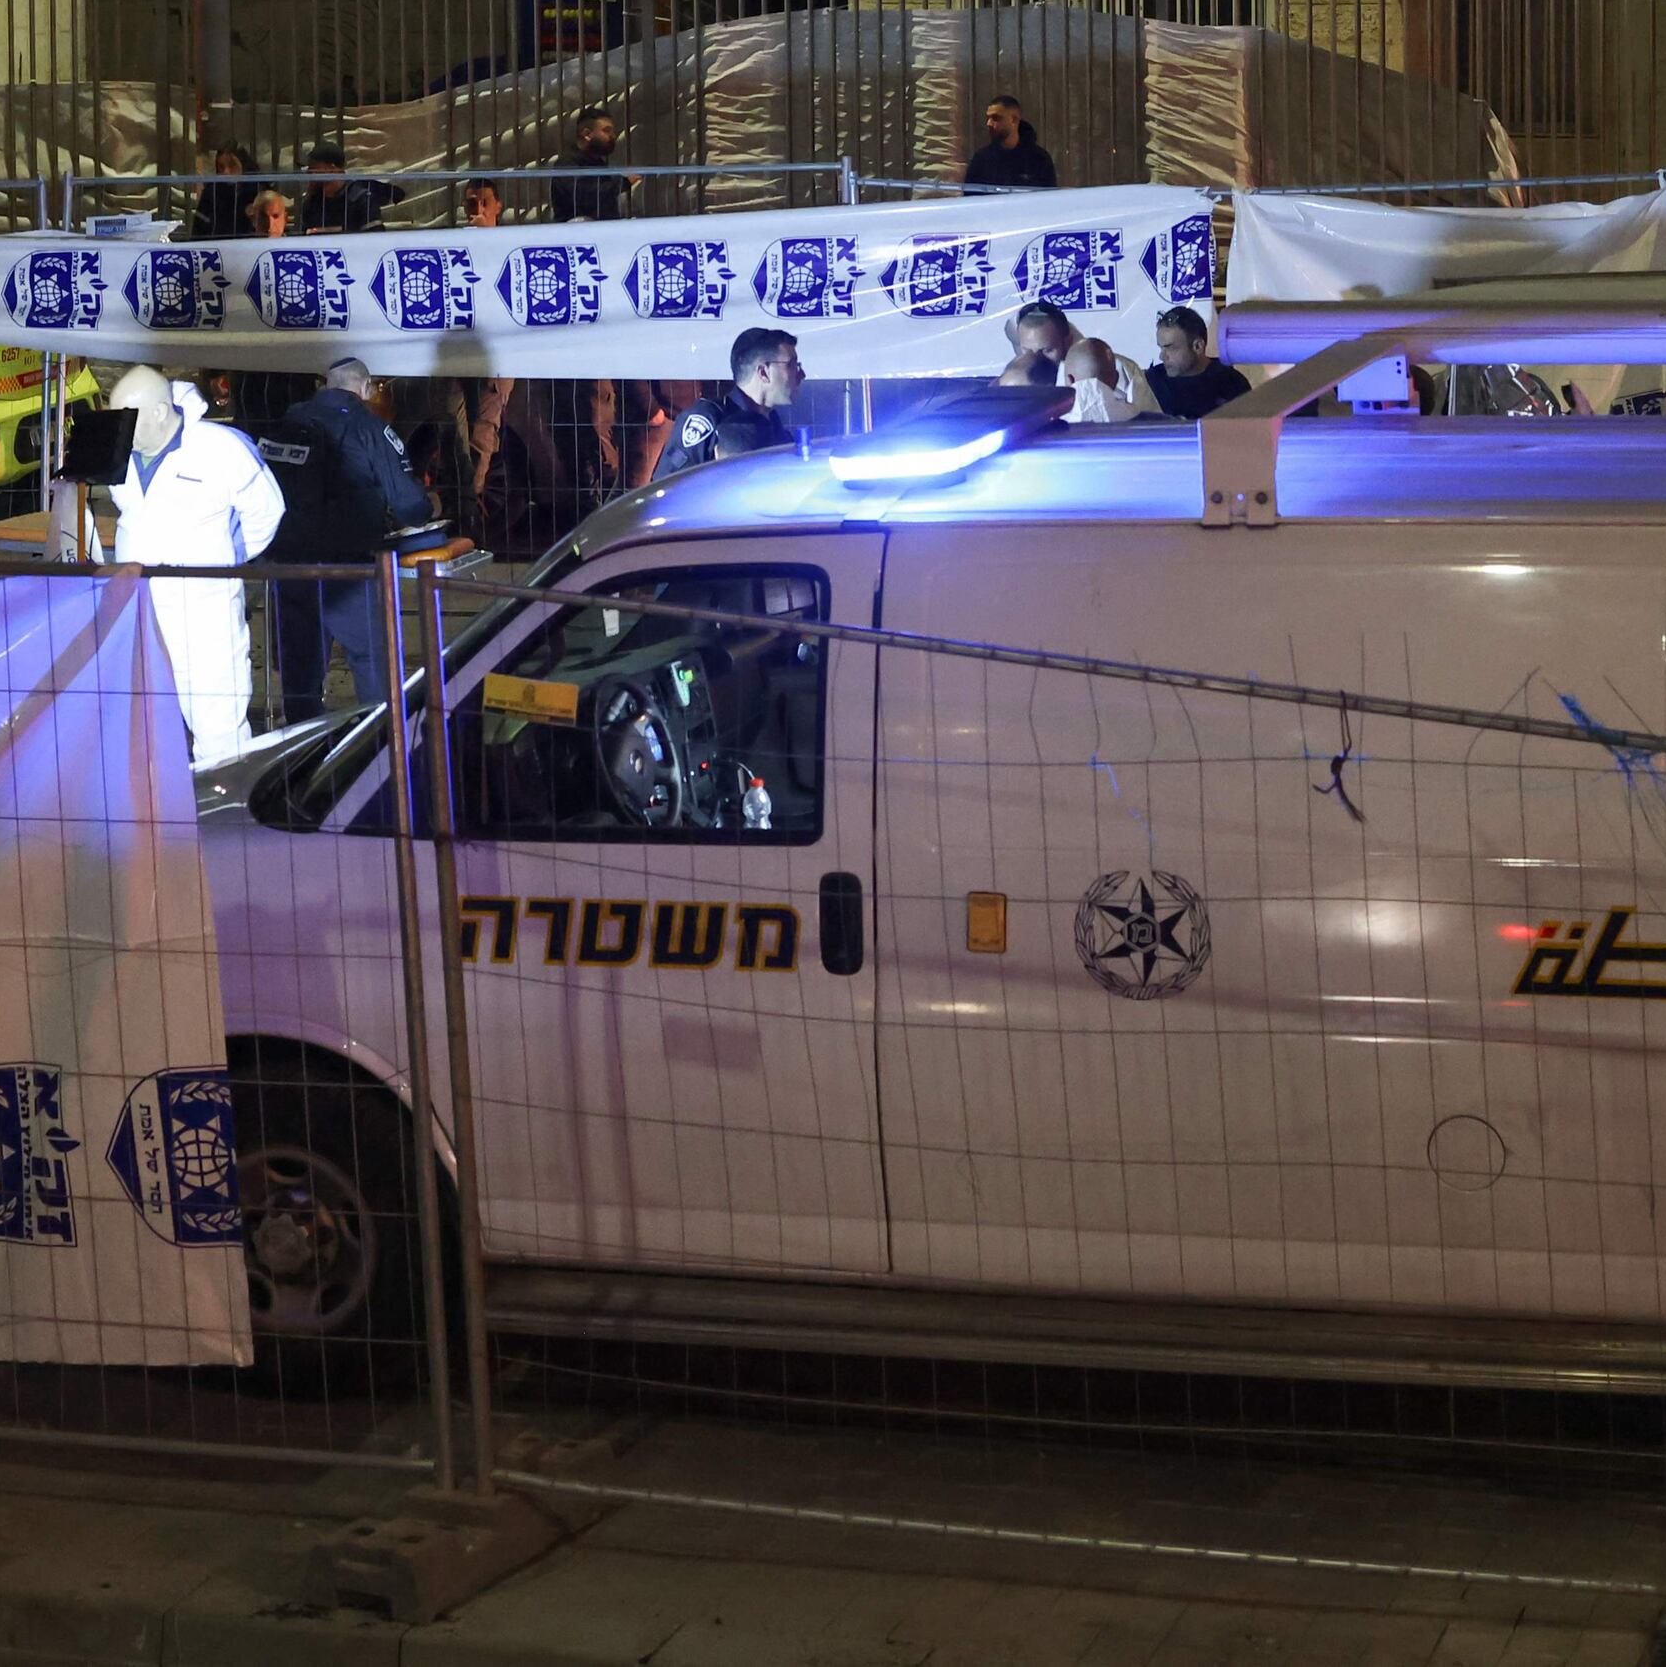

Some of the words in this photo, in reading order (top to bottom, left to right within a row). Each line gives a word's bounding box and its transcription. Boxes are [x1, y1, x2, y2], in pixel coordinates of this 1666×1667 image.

[78, 251, 109, 329] זק"א
[200, 251, 232, 329] זק"א
[323, 250, 356, 329] זק"א
[447, 249, 482, 329] זק"א
[575, 246, 608, 324] זק"א
[702, 242, 736, 318] זק"א
[833, 237, 865, 317] זק"א
[1, 347, 20, 362] 6257
[459, 895, 801, 972] משטרה
[16, 1067, 30, 1119] הצלה
[138, 1103, 155, 1140] אמת
[19, 1125, 31, 1179] חילוץ
[31, 1068, 81, 1242] זק"א
[144, 1147, 160, 1173] של
[22, 1183, 34, 1240] איתור
[149, 1182, 163, 1214] חסד
